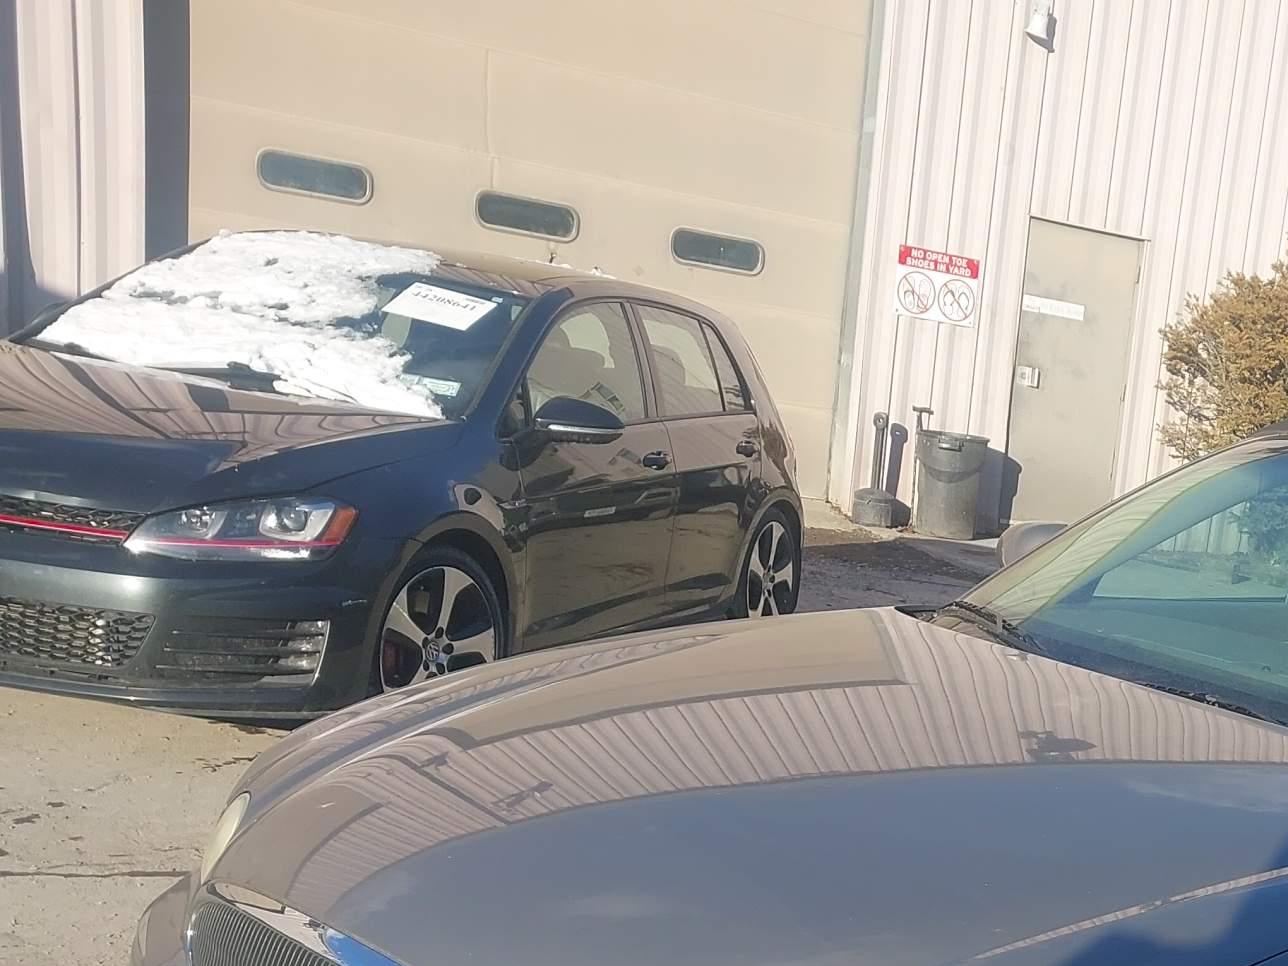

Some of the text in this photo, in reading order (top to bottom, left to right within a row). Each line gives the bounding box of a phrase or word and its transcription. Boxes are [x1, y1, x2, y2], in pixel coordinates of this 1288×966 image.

[906, 257, 971, 276] SHOES IN YARD
[911, 248, 968, 267] NO OPEN TOE
